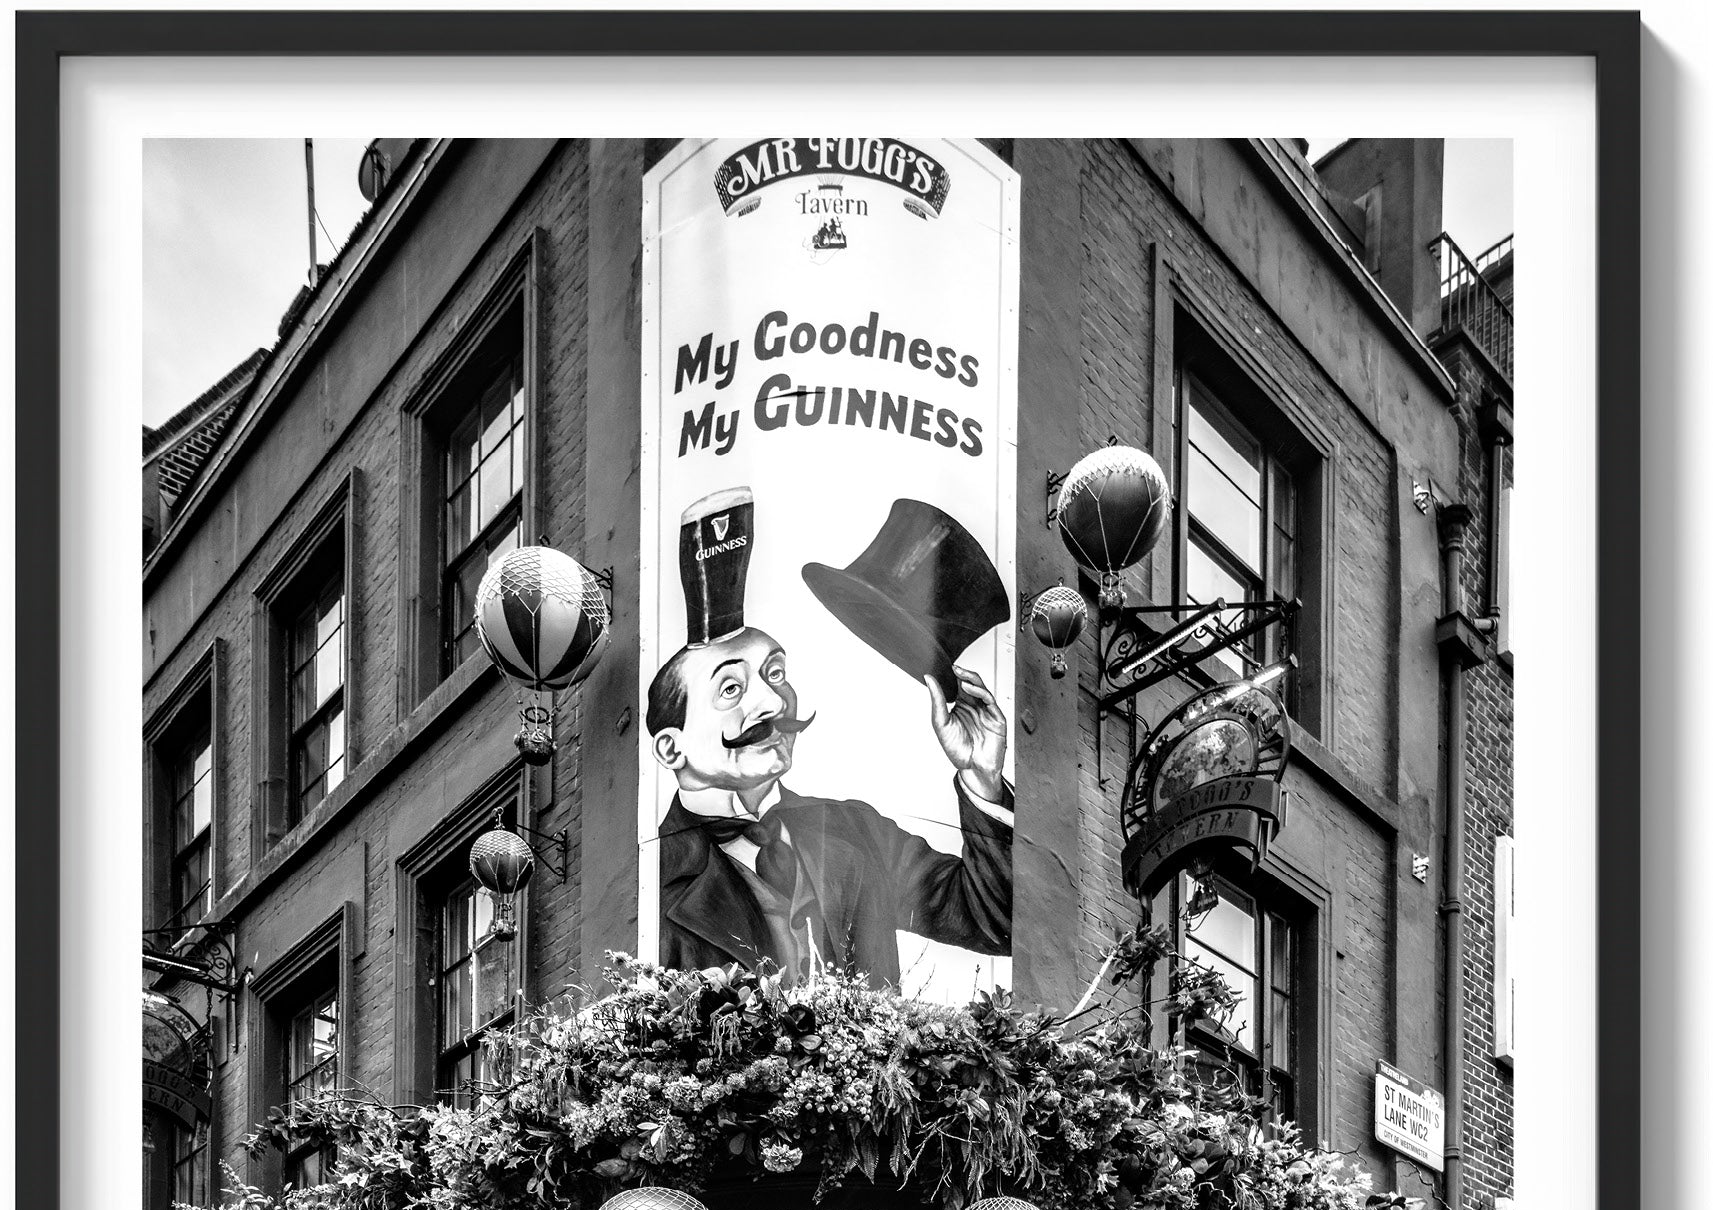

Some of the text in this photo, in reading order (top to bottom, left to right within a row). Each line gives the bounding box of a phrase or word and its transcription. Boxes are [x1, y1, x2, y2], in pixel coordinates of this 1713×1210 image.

[727, 138, 936, 197] MR FOGG'S
[795, 189, 869, 217] Tavern
[674, 310, 979, 395] My Goodness
[678, 373, 983, 458] My GUINNESS
[695, 536, 747, 561] GUINNESS
[1384, 1085, 1440, 1129] ST MARTIN'S
[1384, 1104, 1428, 1142] LANE WC2
